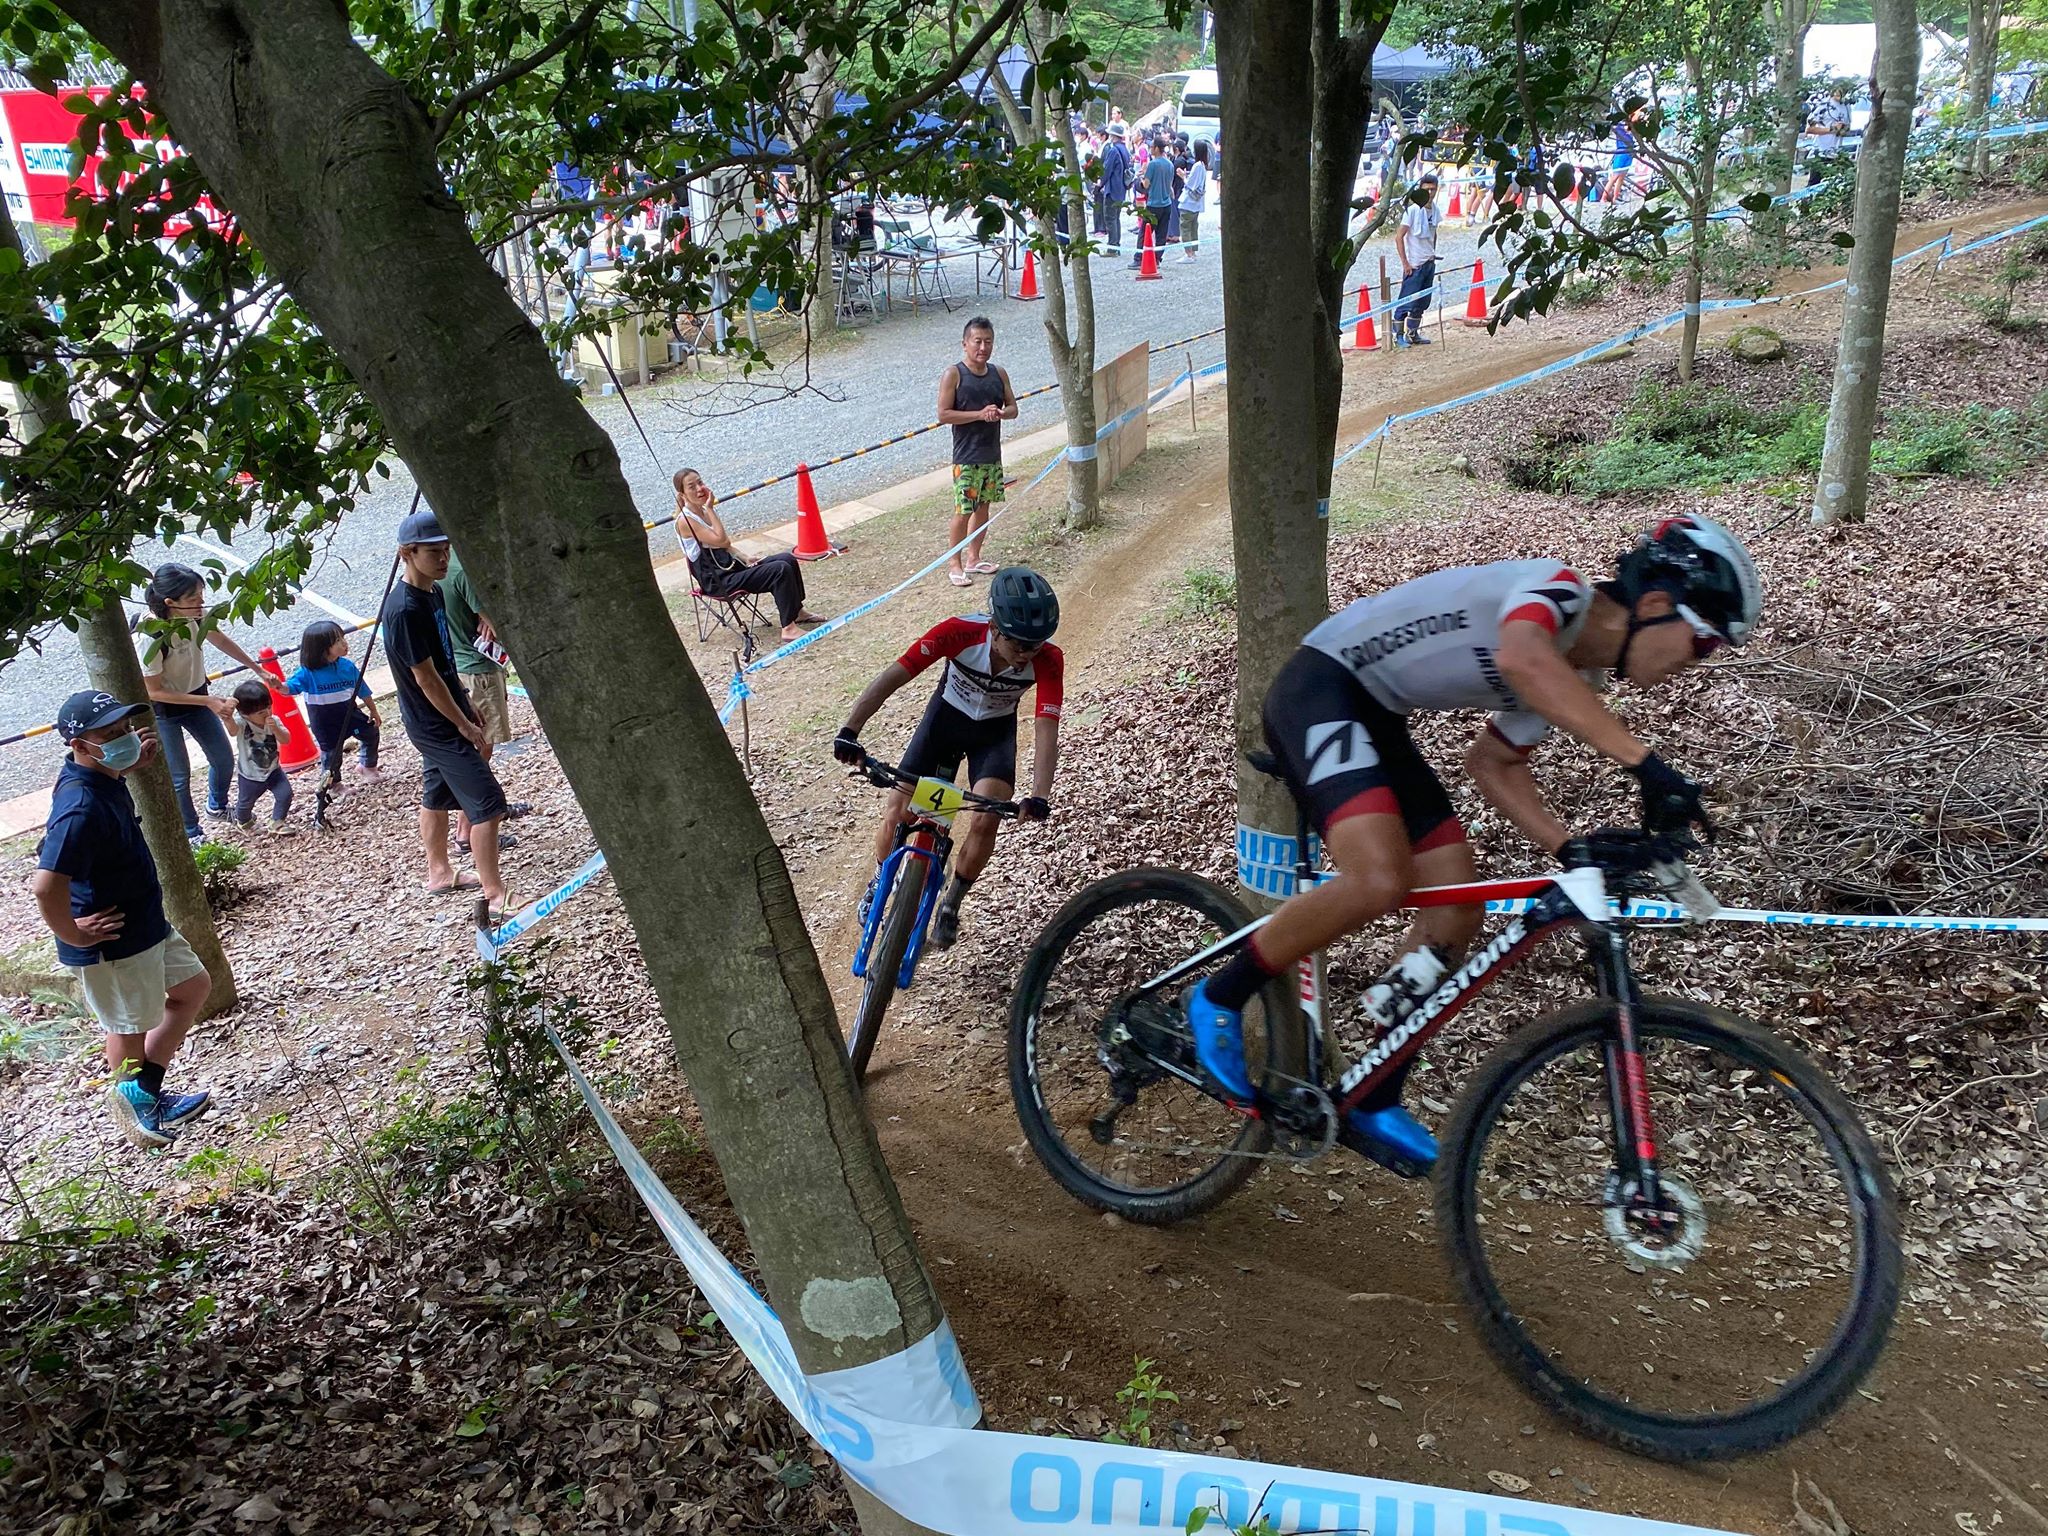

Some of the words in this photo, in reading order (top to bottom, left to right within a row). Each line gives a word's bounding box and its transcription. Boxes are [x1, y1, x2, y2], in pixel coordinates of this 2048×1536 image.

[24, 147, 72, 169] SHIMA
[1200, 362, 1227, 377] SHIM
[1340, 609, 1470, 670] BRIDGESTONE
[929, 788, 945, 811] 4
[1340, 917, 1528, 1094] BRIDGESTONE
